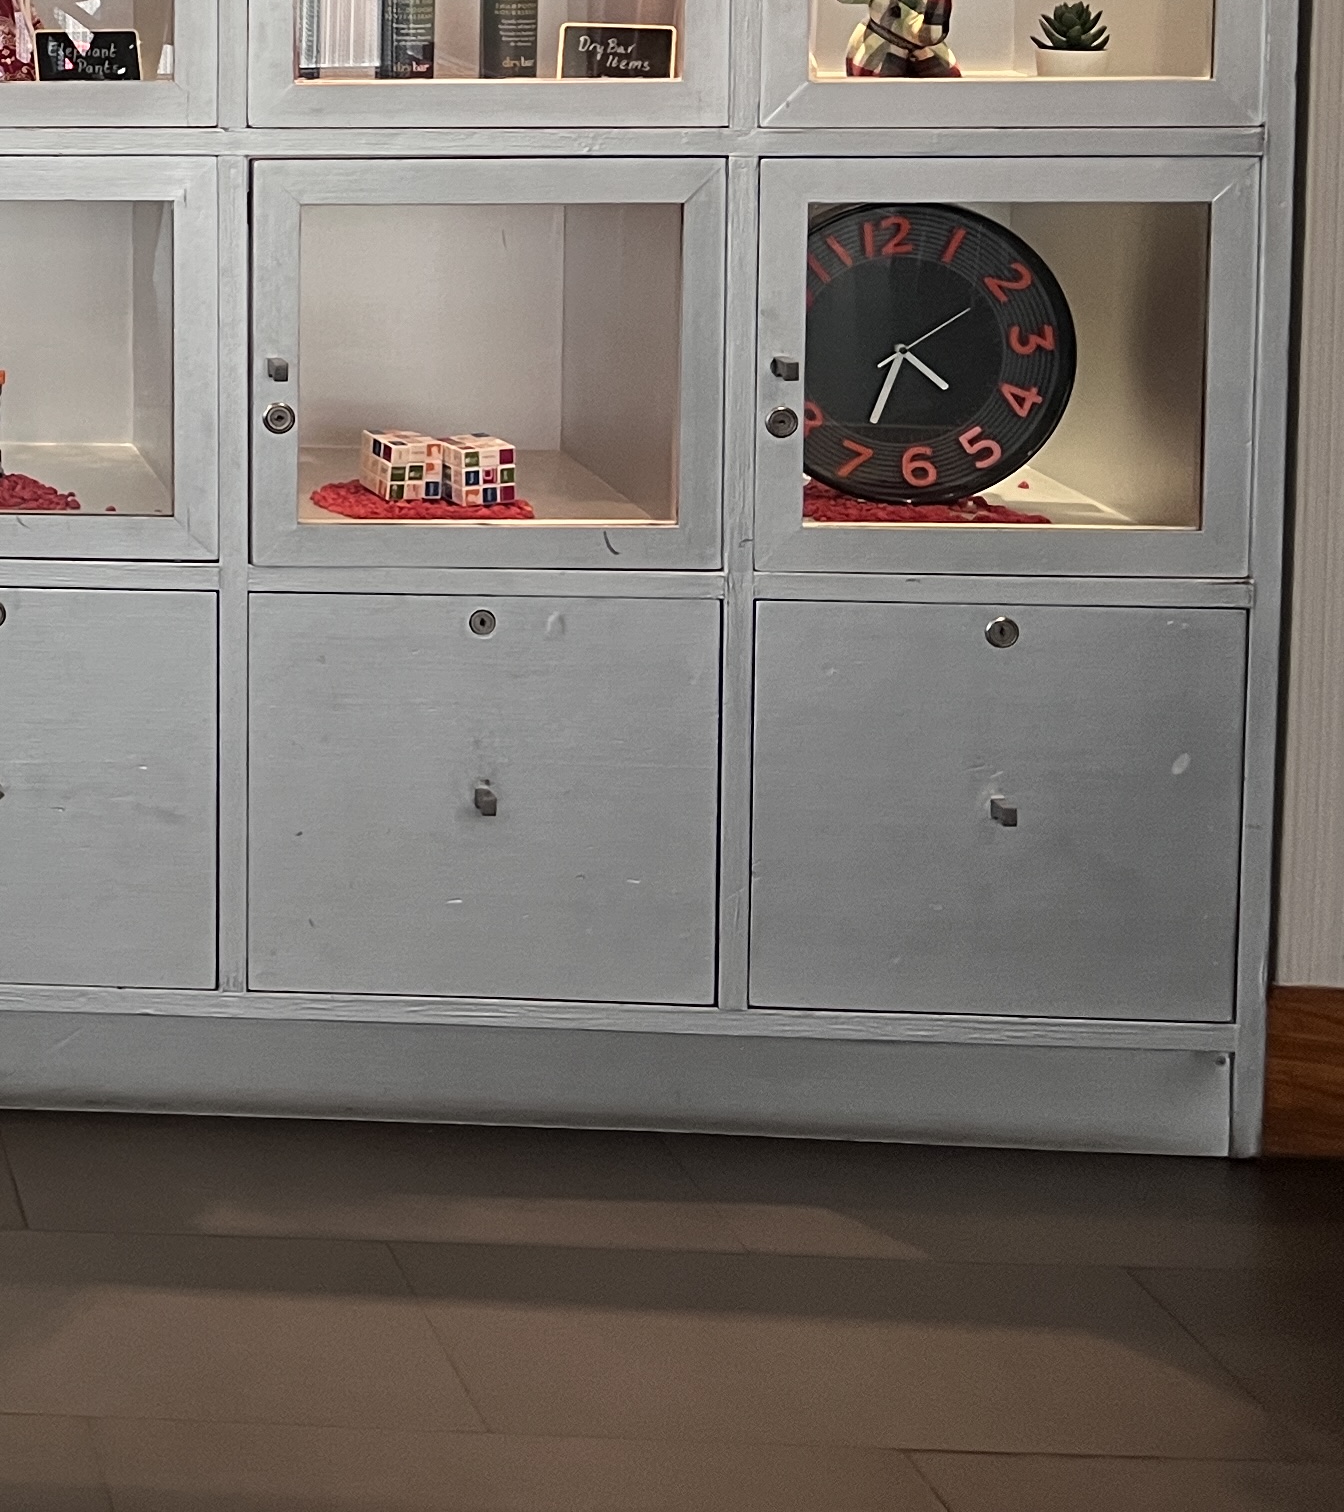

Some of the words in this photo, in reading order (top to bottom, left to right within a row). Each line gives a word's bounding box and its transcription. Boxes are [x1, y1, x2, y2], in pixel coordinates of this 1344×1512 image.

[578, 35, 605, 61] Dry
[607, 37, 637, 54] Bar
[606, 54, 651, 72] Items
[863, 215, 914, 258] 12
[941, 227, 967, 265] 1
[808, 234, 854, 284] 11
[982, 261, 1035, 303] 2
[1008, 323, 1056, 356] 3
[998, 381, 1044, 419] 4
[836, 438, 875, 478] 7
[900, 445, 938, 488] 6
[958, 425, 1004, 470] 5
